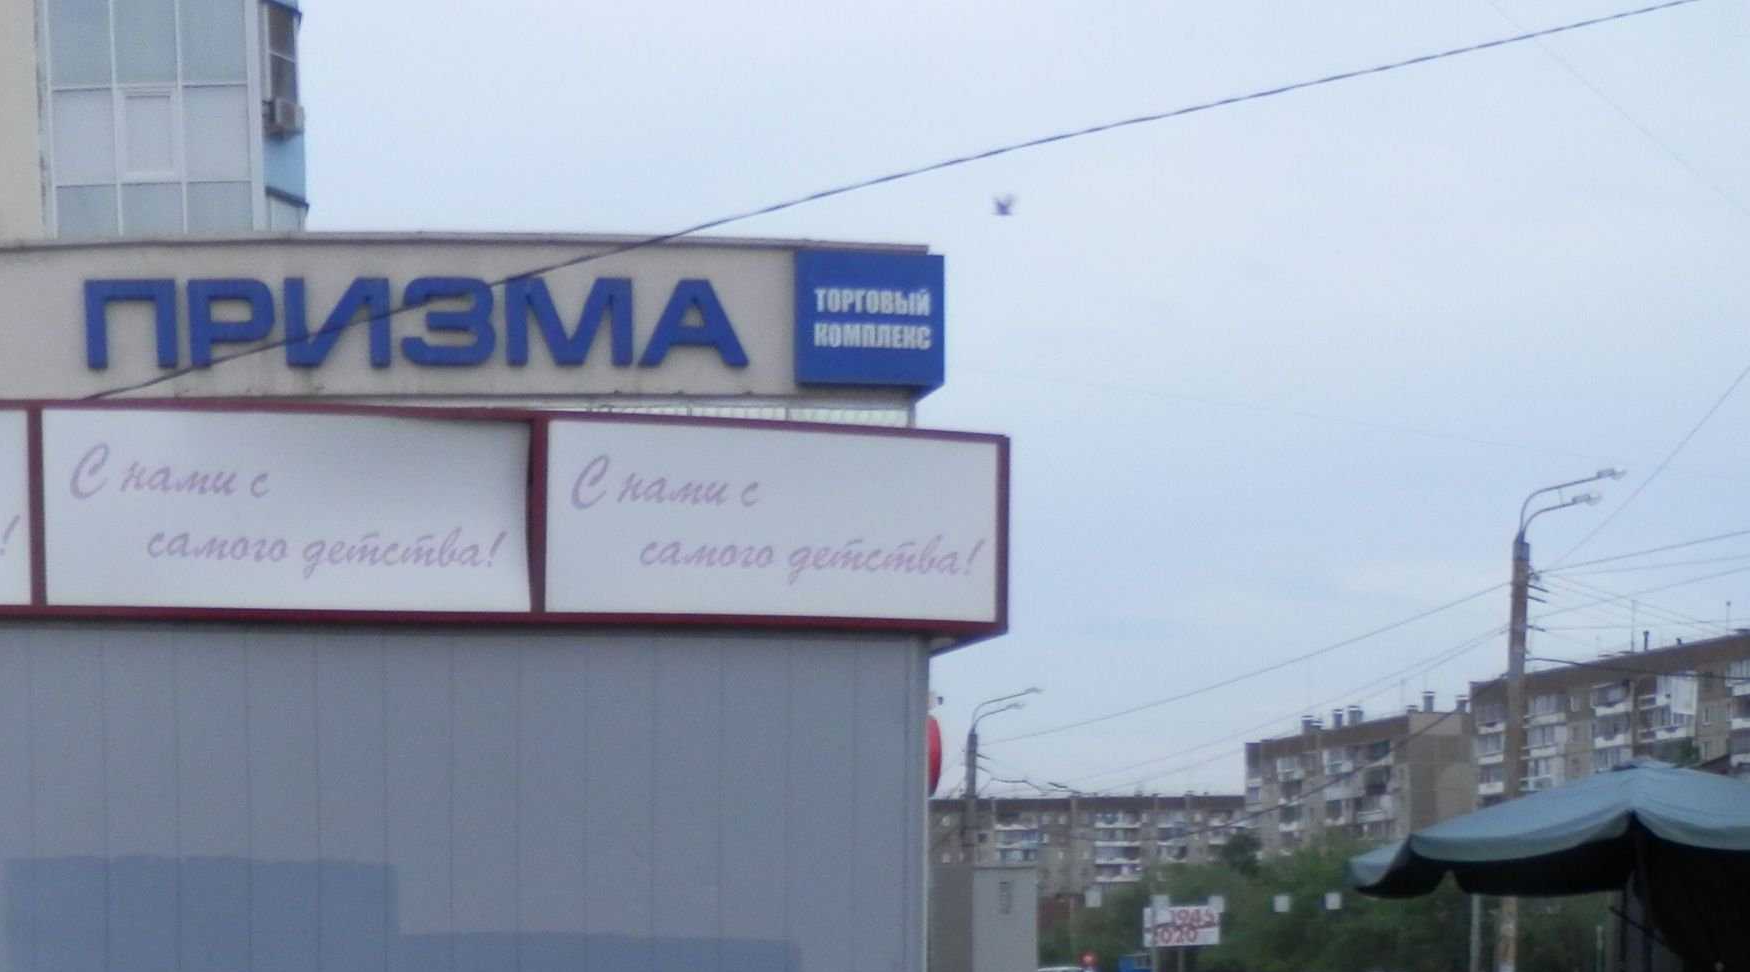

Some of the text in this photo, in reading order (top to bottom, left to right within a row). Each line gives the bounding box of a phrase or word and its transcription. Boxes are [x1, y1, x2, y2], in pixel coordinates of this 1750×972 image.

[84, 276, 748, 372] ПРИЗМА
[814, 287, 931, 316] ТОРГОВЫЙ
[814, 322, 932, 350] КОМПЛЕКС
[70, 443, 110, 499] С
[120, 460, 238, 496] нами
[571, 454, 611, 510] С
[616, 470, 728, 506] нами
[147, 526, 507, 579] самого детства!
[640, 533, 986, 585] самого детства!
